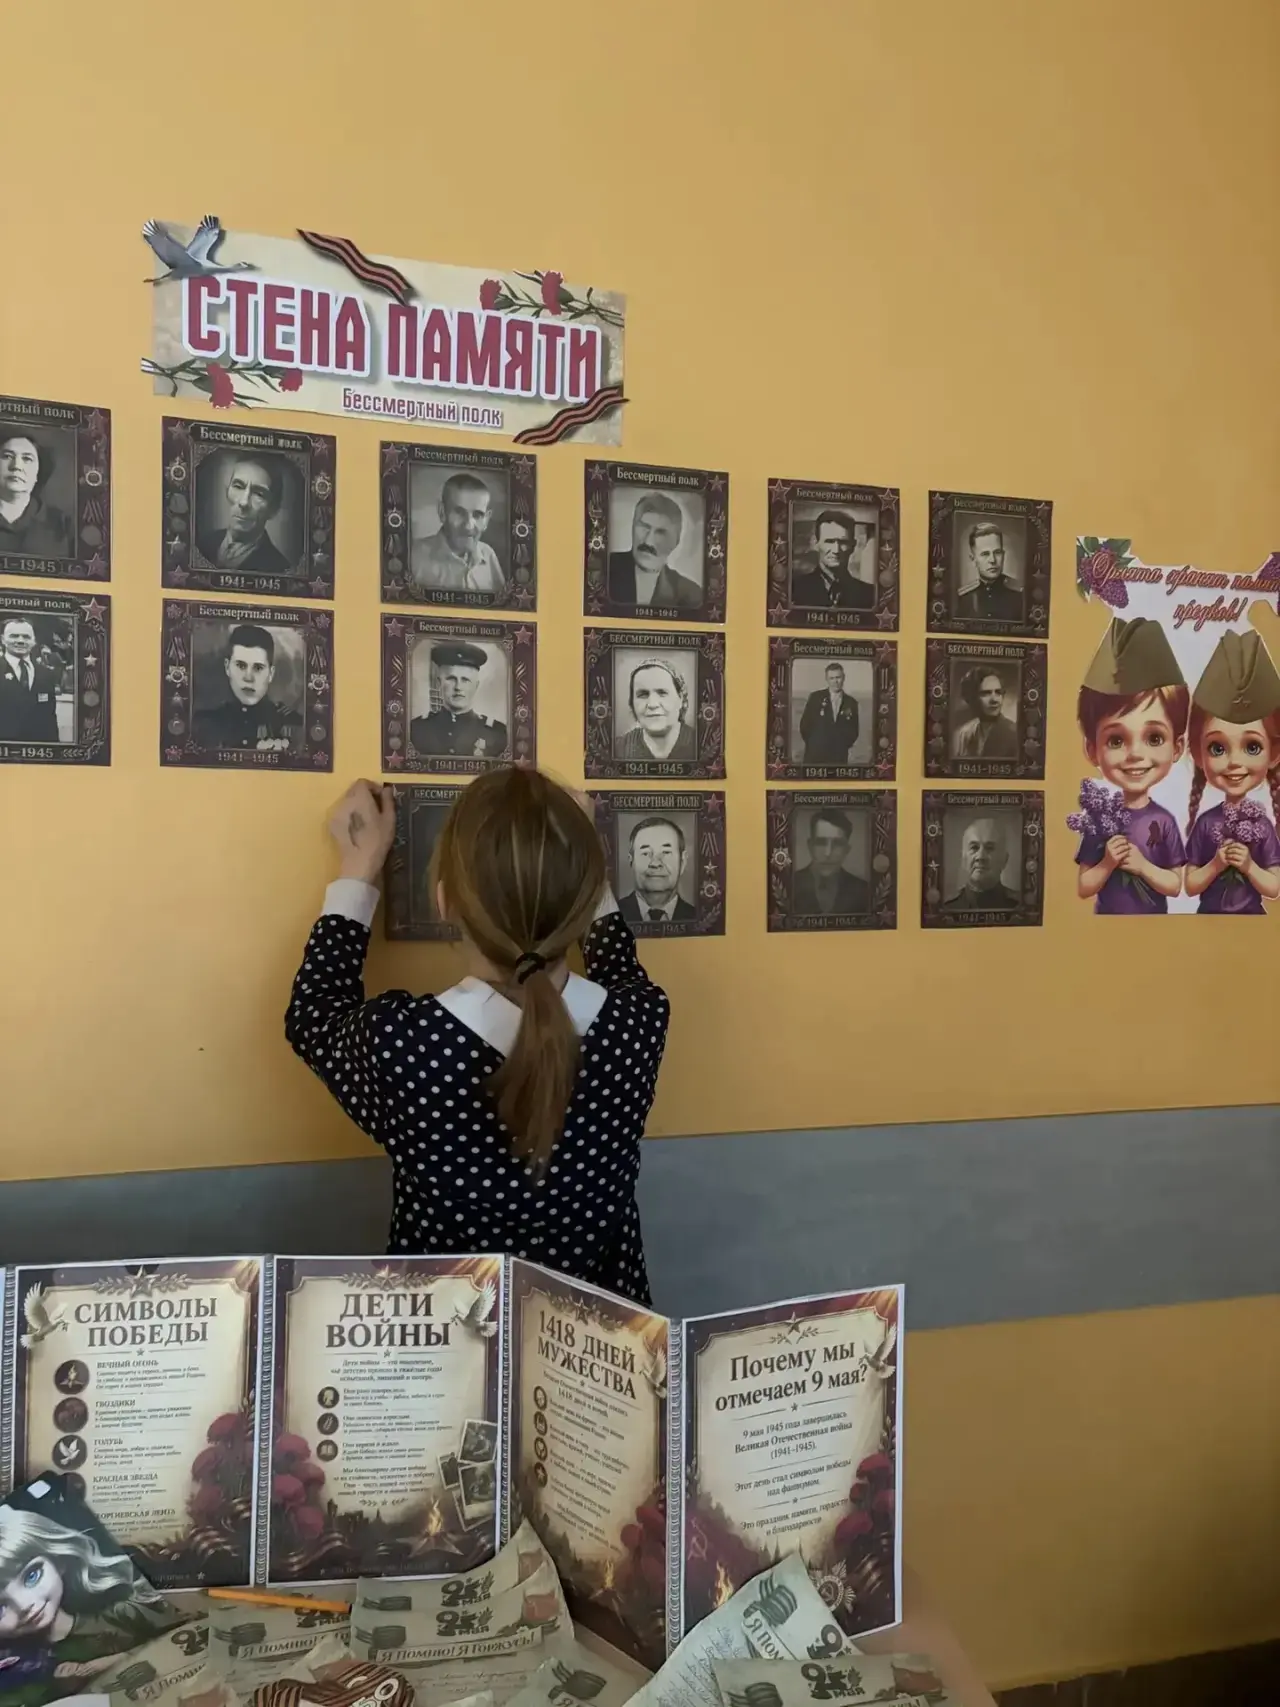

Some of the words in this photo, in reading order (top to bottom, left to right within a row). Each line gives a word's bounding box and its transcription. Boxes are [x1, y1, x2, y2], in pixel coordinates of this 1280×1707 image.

[186, 275, 367, 373] СТЕНА
[387, 303, 600, 398] ПАМЯТИ
[44, 407, 75, 420] полк
[342, 388, 458, 422] Бессмертный
[461, 406, 502, 428] полк
[200, 427, 274, 446] Бессмертный
[414, 447, 478, 464] Бессмертный
[617, 466, 677, 484] Бессмертный
[678, 475, 699, 486] полк
[796, 487, 852, 501] Бессмертный
[219, 575, 281, 591] 1941-1945
[44, 600, 72, 609] полк
[431, 591, 489, 605] 1941-1945
[199, 605, 272, 621] Бессмертный
[274, 611, 300, 622] полк
[1172, 595, 1249, 632] предков!
[419, 621, 478, 636] Бессмертный
[609, 633, 675, 645] БЕССМЕРТНЫЙ
[678, 636, 701, 647] ПОЛК
[794, 642, 852, 656] Бессмертный
[948, 644, 1004, 656] БЕССМЕРТНЫЙ
[625, 763, 684, 775] 1941-1945
[414, 789, 463, 799] БЕССМЕРТ
[613, 795, 675, 808] БЕССМЕРТНЫЙ
[677, 795, 700, 808] ПОЛК
[74, 1297, 218, 1325] СИМВОЛЫ
[339, 1292, 434, 1322] ДЕТИ
[87, 1321, 210, 1348] ПОБЕДЫ
[325, 1317, 451, 1349] ВОЙНЫ
[539, 1309, 576, 1348] 1418
[582, 1333, 637, 1375] ДНЕЙ
[537, 1335, 637, 1400] МУЖЕСТВА
[729, 1347, 817, 1382] Почему
[822, 1341, 856, 1364] мы
[715, 1378, 808, 1412] отмечаем
[811, 1369, 824, 1392] 9
[827, 1362, 868, 1390] мая?
[735, 1439, 770, 1454] Великая
[770, 1427, 829, 1446] Отечественная
[830, 1421, 853, 1433] война
[742, 1430, 749, 1439] 9
[749, 1428, 764, 1438] мая
[766, 1422, 784, 1435] 1945
[784, 1420, 801, 1431] года
[771, 1473, 789, 1484] стал
[240, 1647, 254, 1660] Я
[381, 1650, 393, 1662] Я
[456, 1645, 469, 1657] Я
